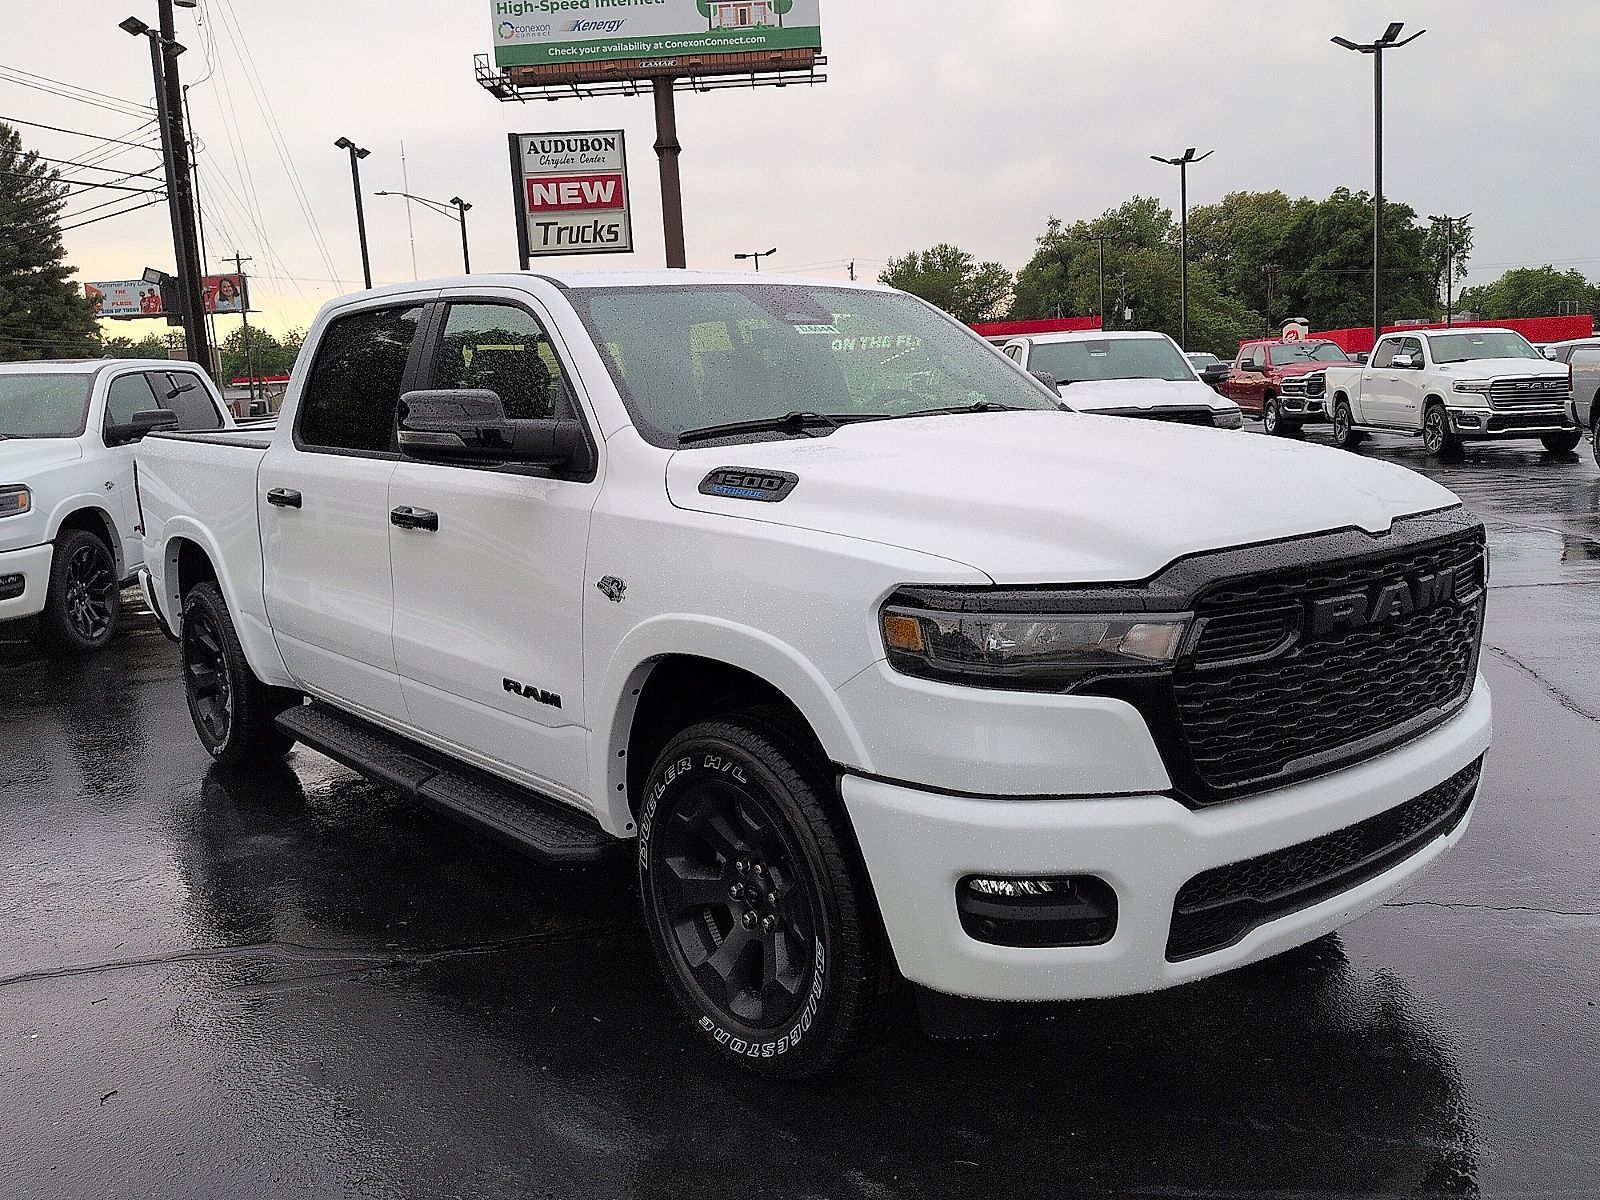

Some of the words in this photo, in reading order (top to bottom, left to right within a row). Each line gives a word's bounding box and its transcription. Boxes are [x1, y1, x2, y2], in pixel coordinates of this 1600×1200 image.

[497, 0, 590, 16] High-Speed
[515, 23, 551, 33] conexon
[572, 19, 625, 32] Kenergy
[548, 47, 578, 56] Check
[579, 46, 601, 56] your
[602, 42, 652, 54] availability
[653, 42, 663, 50] at
[664, 36, 766, 49] ConexonConnect.com
[641, 60, 675, 68] LAMAR
[527, 137, 616, 154] AUDUBON
[540, 154, 574, 168] Chrysler
[580, 153, 606, 164] Center
[532, 181, 616, 206] NEW
[535, 220, 620, 246] Trucks
[716, 473, 781, 489] 1500
[1312, 568, 1453, 635] RAM
[503, 677, 562, 709] RAM
[639, 757, 692, 870] DUELER
[703, 755, 747, 784] H/L
[698, 936, 825, 1058] BRIDGESTONE
